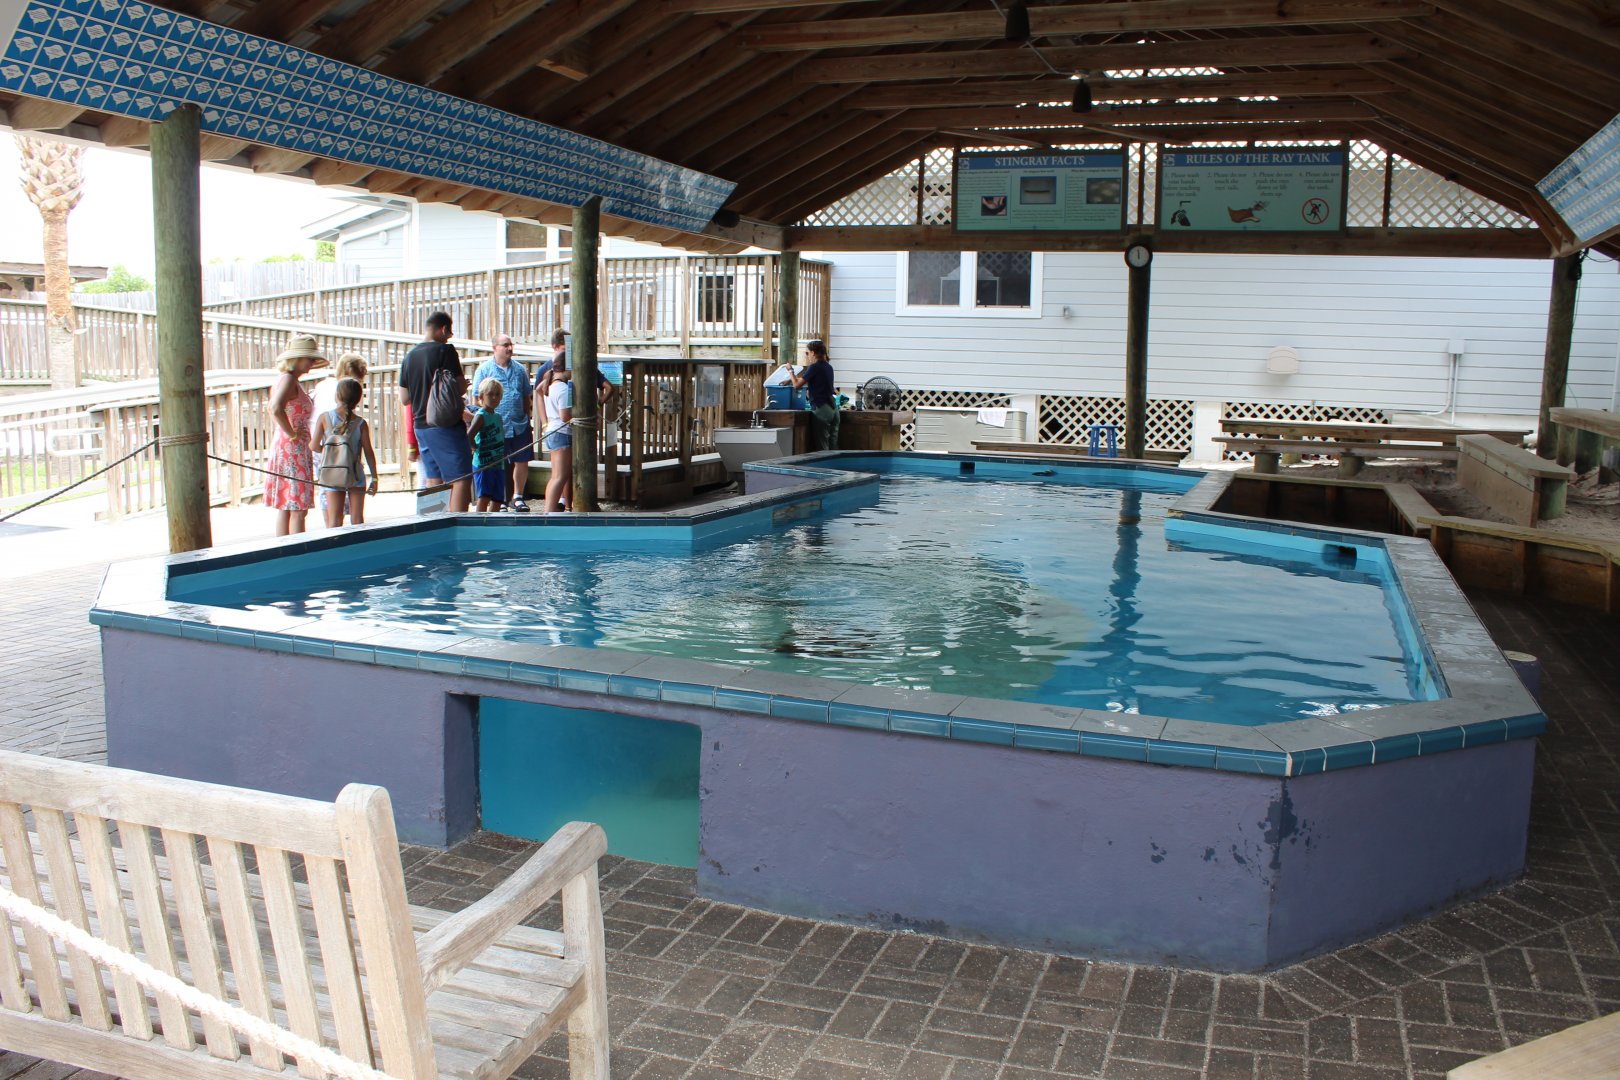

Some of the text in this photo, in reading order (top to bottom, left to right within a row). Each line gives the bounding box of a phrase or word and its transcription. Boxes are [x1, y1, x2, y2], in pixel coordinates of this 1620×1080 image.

[994, 155, 1085, 167] STINGRAY FACTS
[1186, 152, 1330, 164] RULES OF THE RAY TANK
